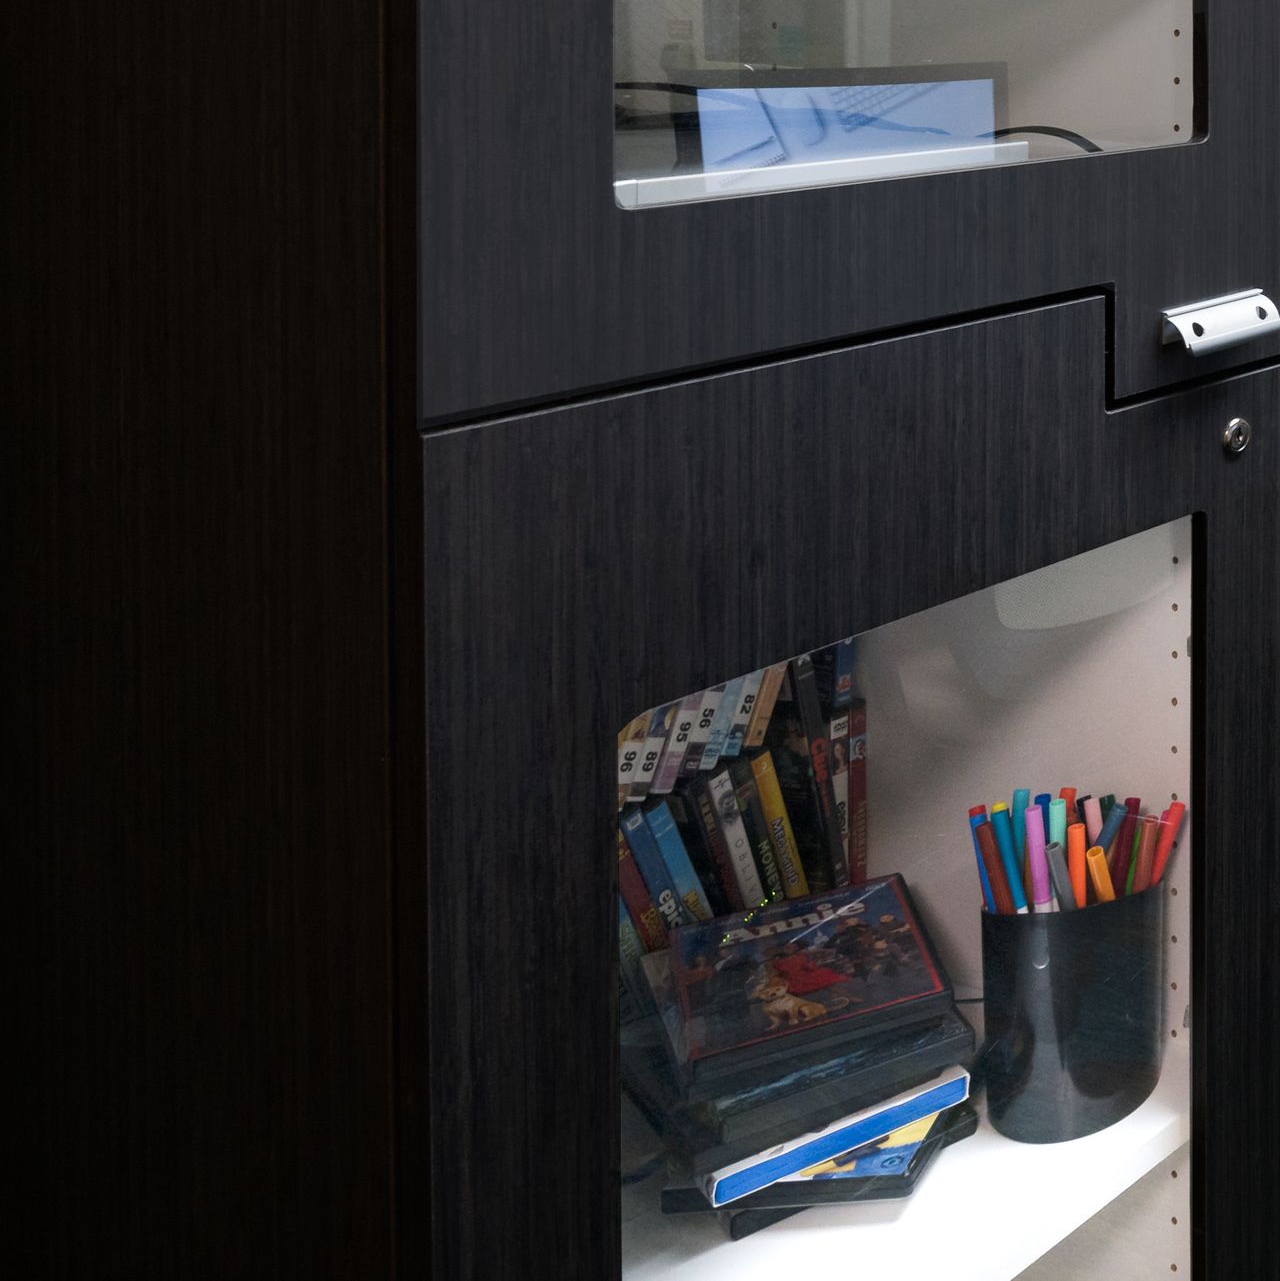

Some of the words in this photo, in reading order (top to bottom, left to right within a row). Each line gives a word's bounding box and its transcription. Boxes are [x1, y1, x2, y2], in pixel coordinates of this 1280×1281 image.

[740, 694, 755, 714] 82
[700, 708, 715, 729] 56
[676, 722, 691, 742] 95
[620, 751, 636, 772] 96
[642, 751, 657, 772] 89
[771, 816, 799, 886] MEGAMIND
[659, 888, 682, 928] epic
[719, 902, 865, 948] Annie
